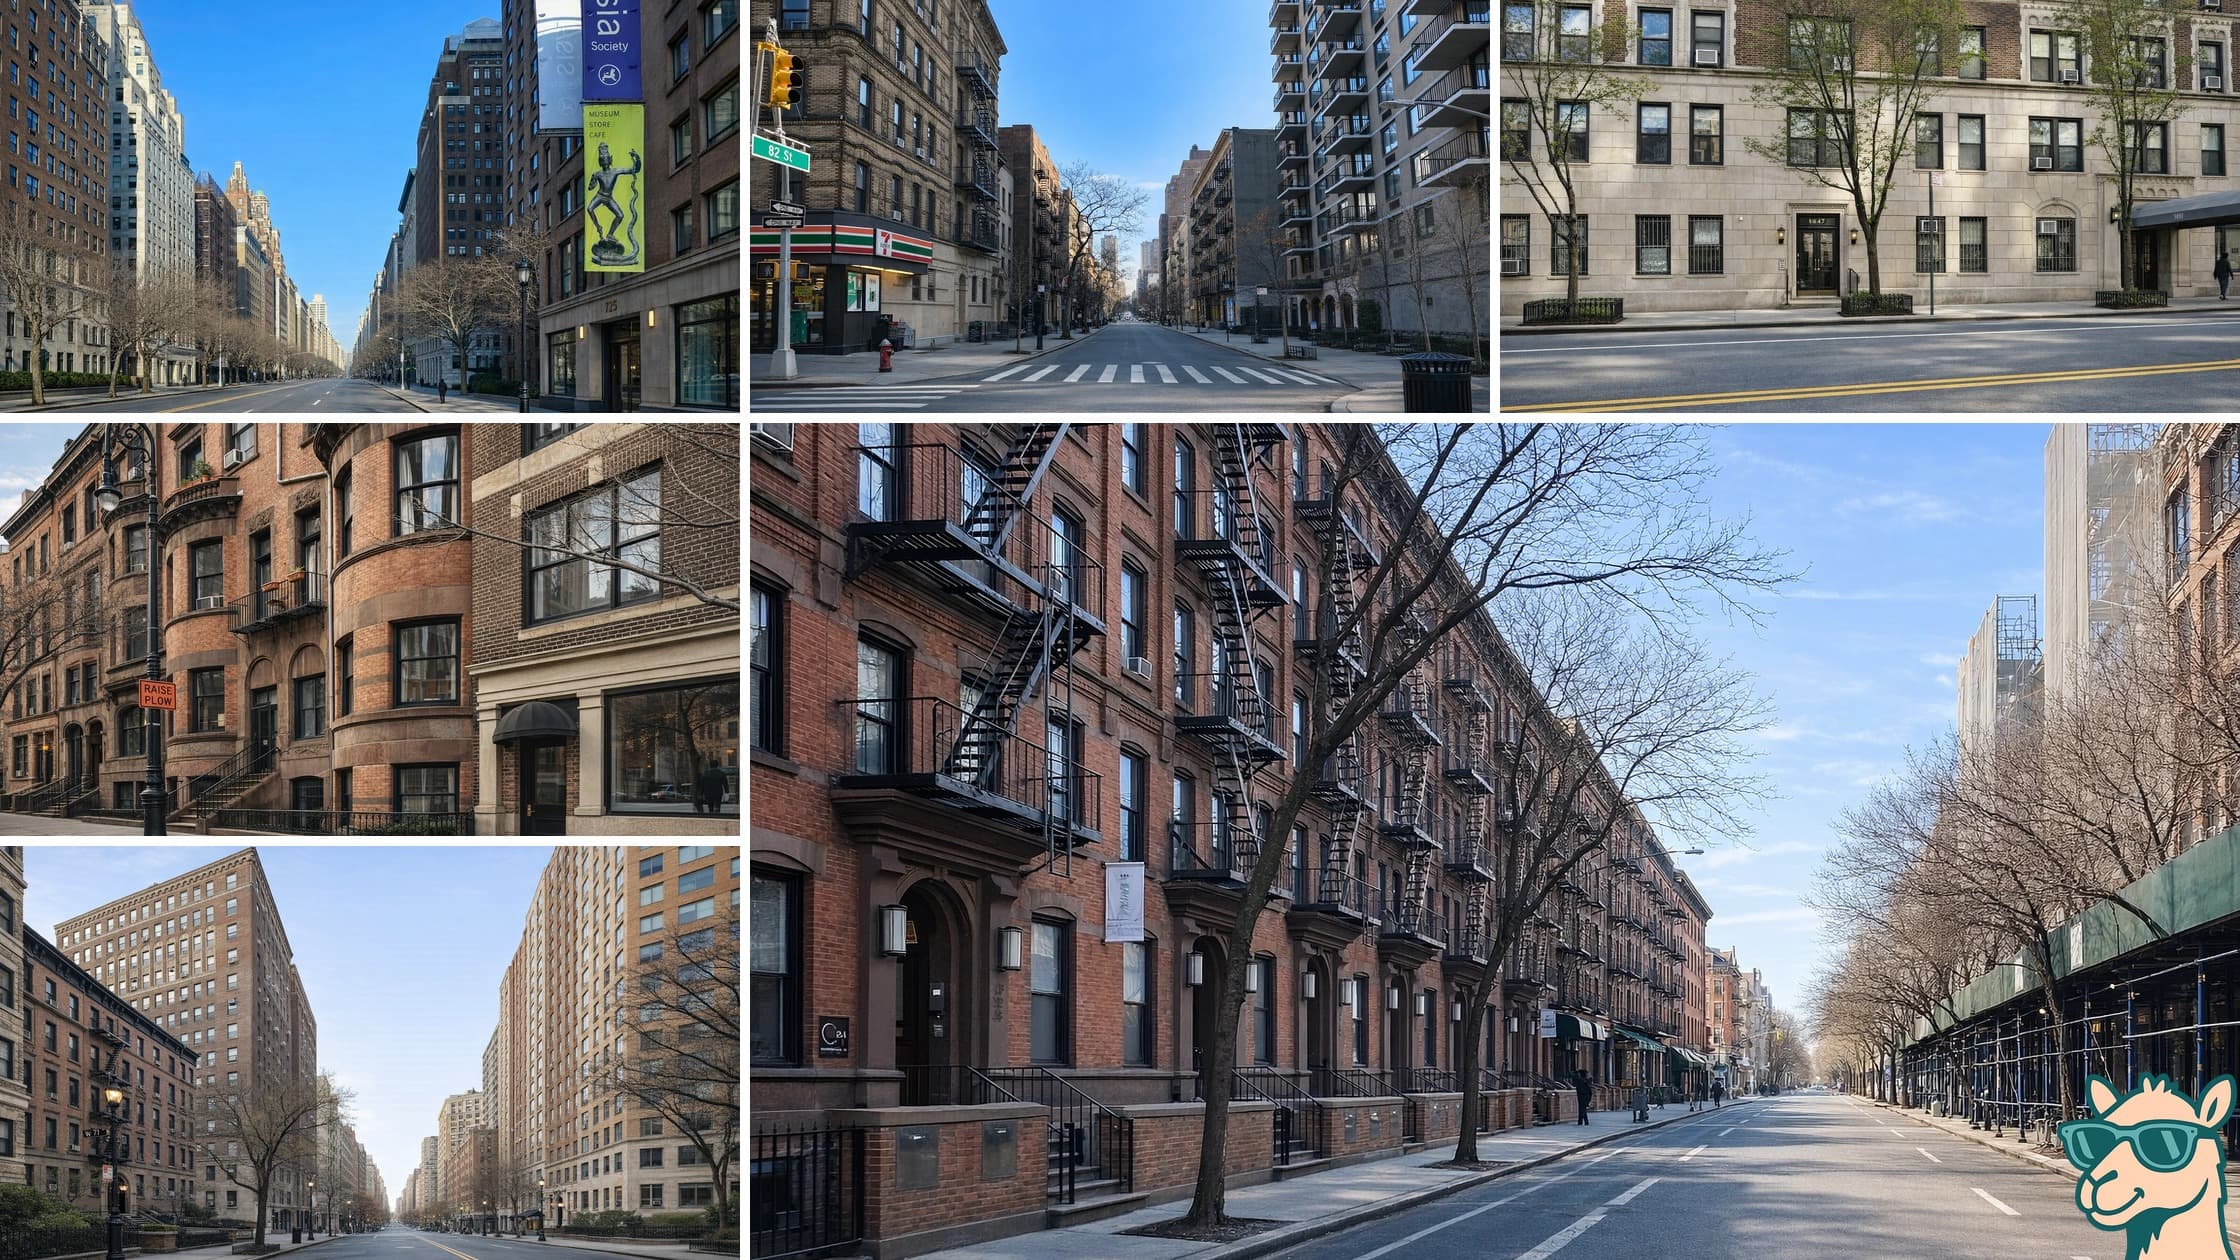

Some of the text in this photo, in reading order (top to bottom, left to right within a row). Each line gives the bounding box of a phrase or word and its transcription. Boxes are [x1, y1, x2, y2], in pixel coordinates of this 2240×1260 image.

[591, 40, 629, 53] Society
[589, 110, 620, 118] MUSEUM
[768, 145, 793, 162] 82 St
[144, 684, 172, 695] RAISE
[144, 695, 172, 706] PLOW
